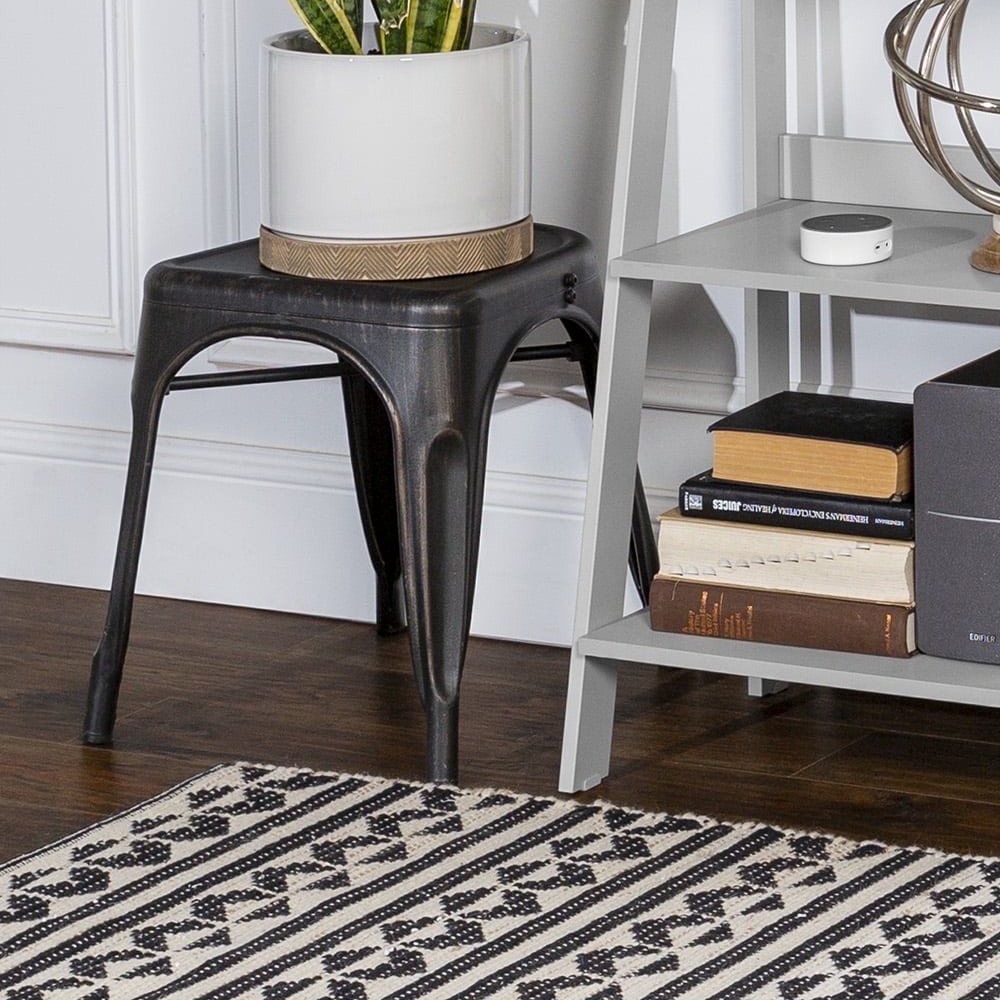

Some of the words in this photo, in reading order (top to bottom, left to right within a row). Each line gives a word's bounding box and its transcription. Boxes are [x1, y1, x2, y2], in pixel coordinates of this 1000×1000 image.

[712, 499, 742, 512] JUICES
[742, 503, 771, 514] HEALING
[770, 504, 777, 514] of
[777, 505, 825, 519] ENCYCLOPEDIA
